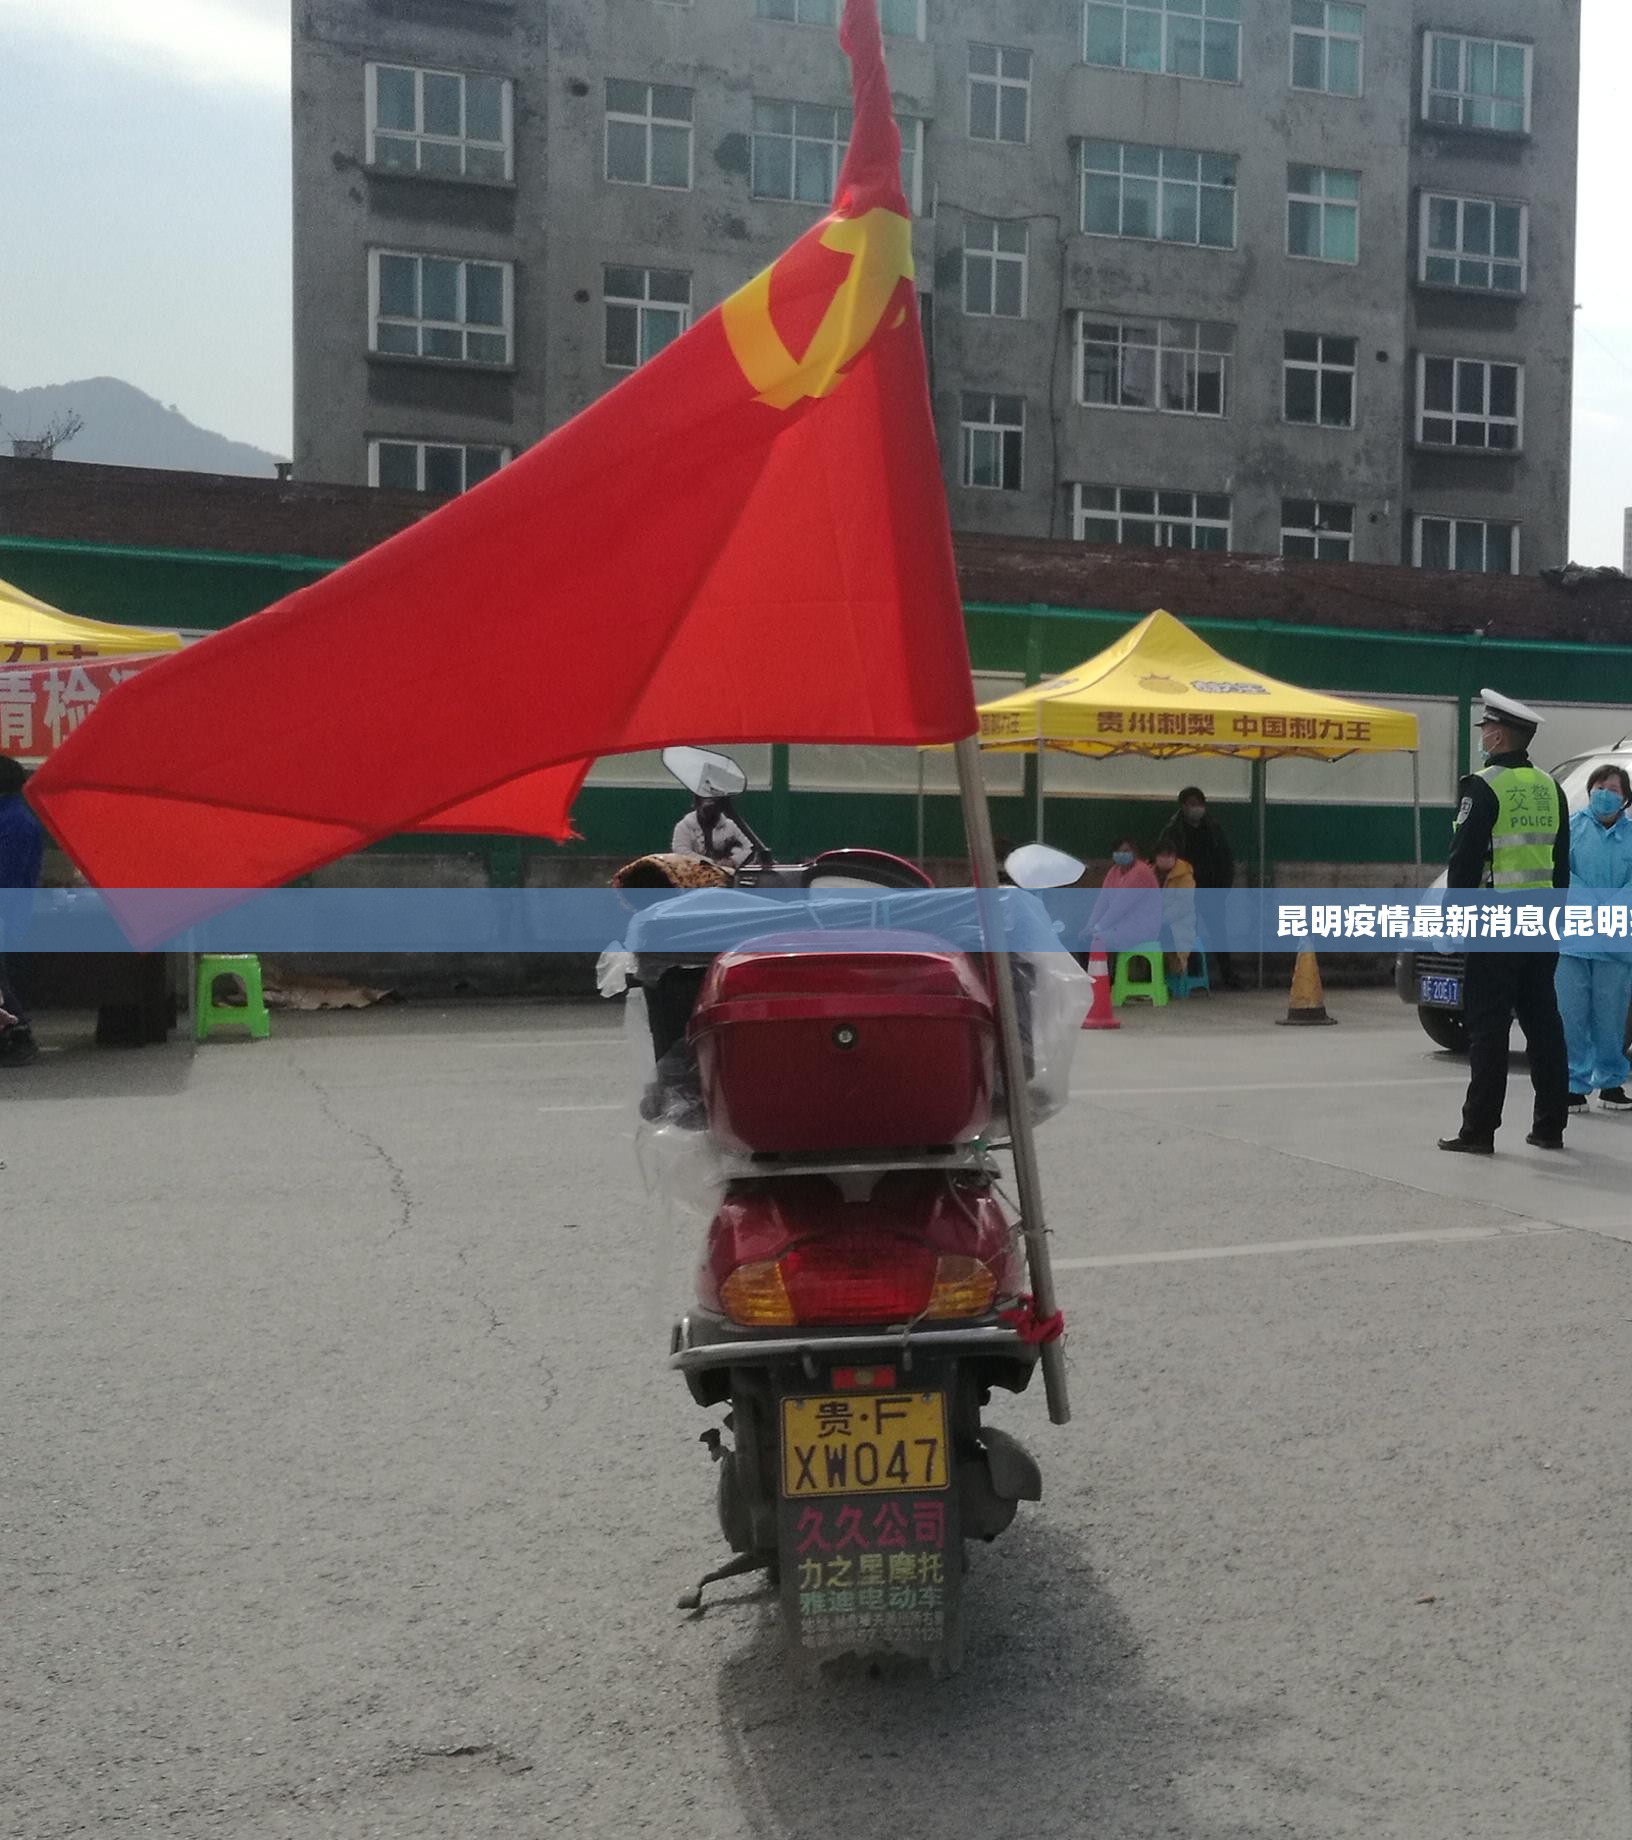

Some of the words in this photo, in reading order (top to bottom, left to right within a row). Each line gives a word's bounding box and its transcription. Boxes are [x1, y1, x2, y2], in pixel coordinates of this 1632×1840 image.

[1096, 711, 1216, 736] 贵州刺梨
[1232, 715, 1371, 742] 中国刺力王
[1506, 784, 1552, 812] 交警
[1511, 815, 1553, 828] POLICE
[794, 1438, 938, 1490] XW047
[796, 1501, 945, 1553] 久久公司
[798, 1551, 945, 1589] 力之星摩托
